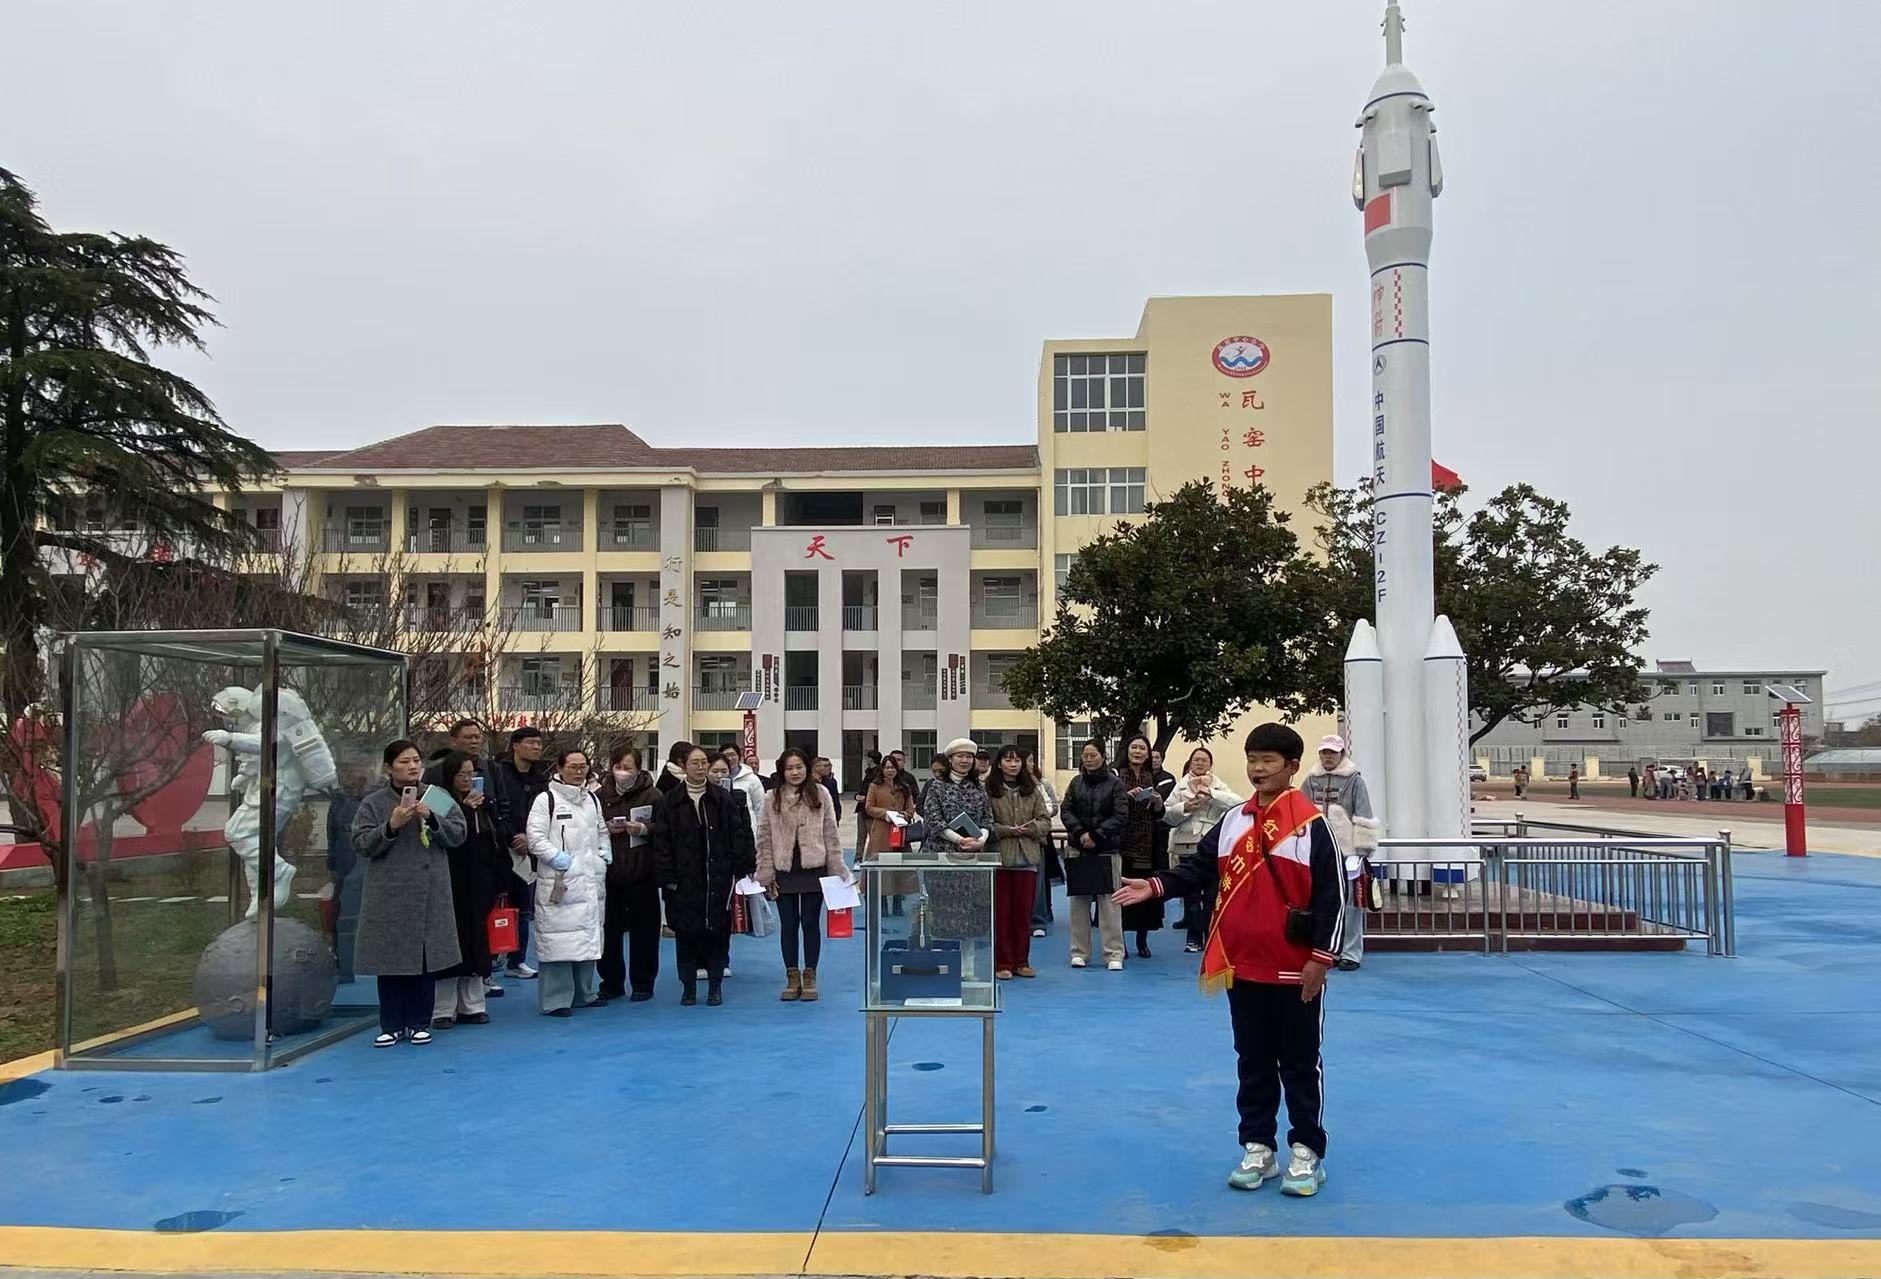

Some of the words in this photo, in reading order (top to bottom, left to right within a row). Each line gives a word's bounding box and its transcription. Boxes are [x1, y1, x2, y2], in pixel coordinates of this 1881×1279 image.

[1220, 392, 1231, 408] WA
[1221, 429, 1230, 450] YAO
[1242, 390, 1265, 487] 瓦窑中
[1375, 390, 1385, 486] 中国航天
[805, 535, 915, 560] 天下
[662, 555, 683, 699] 行是知之始
